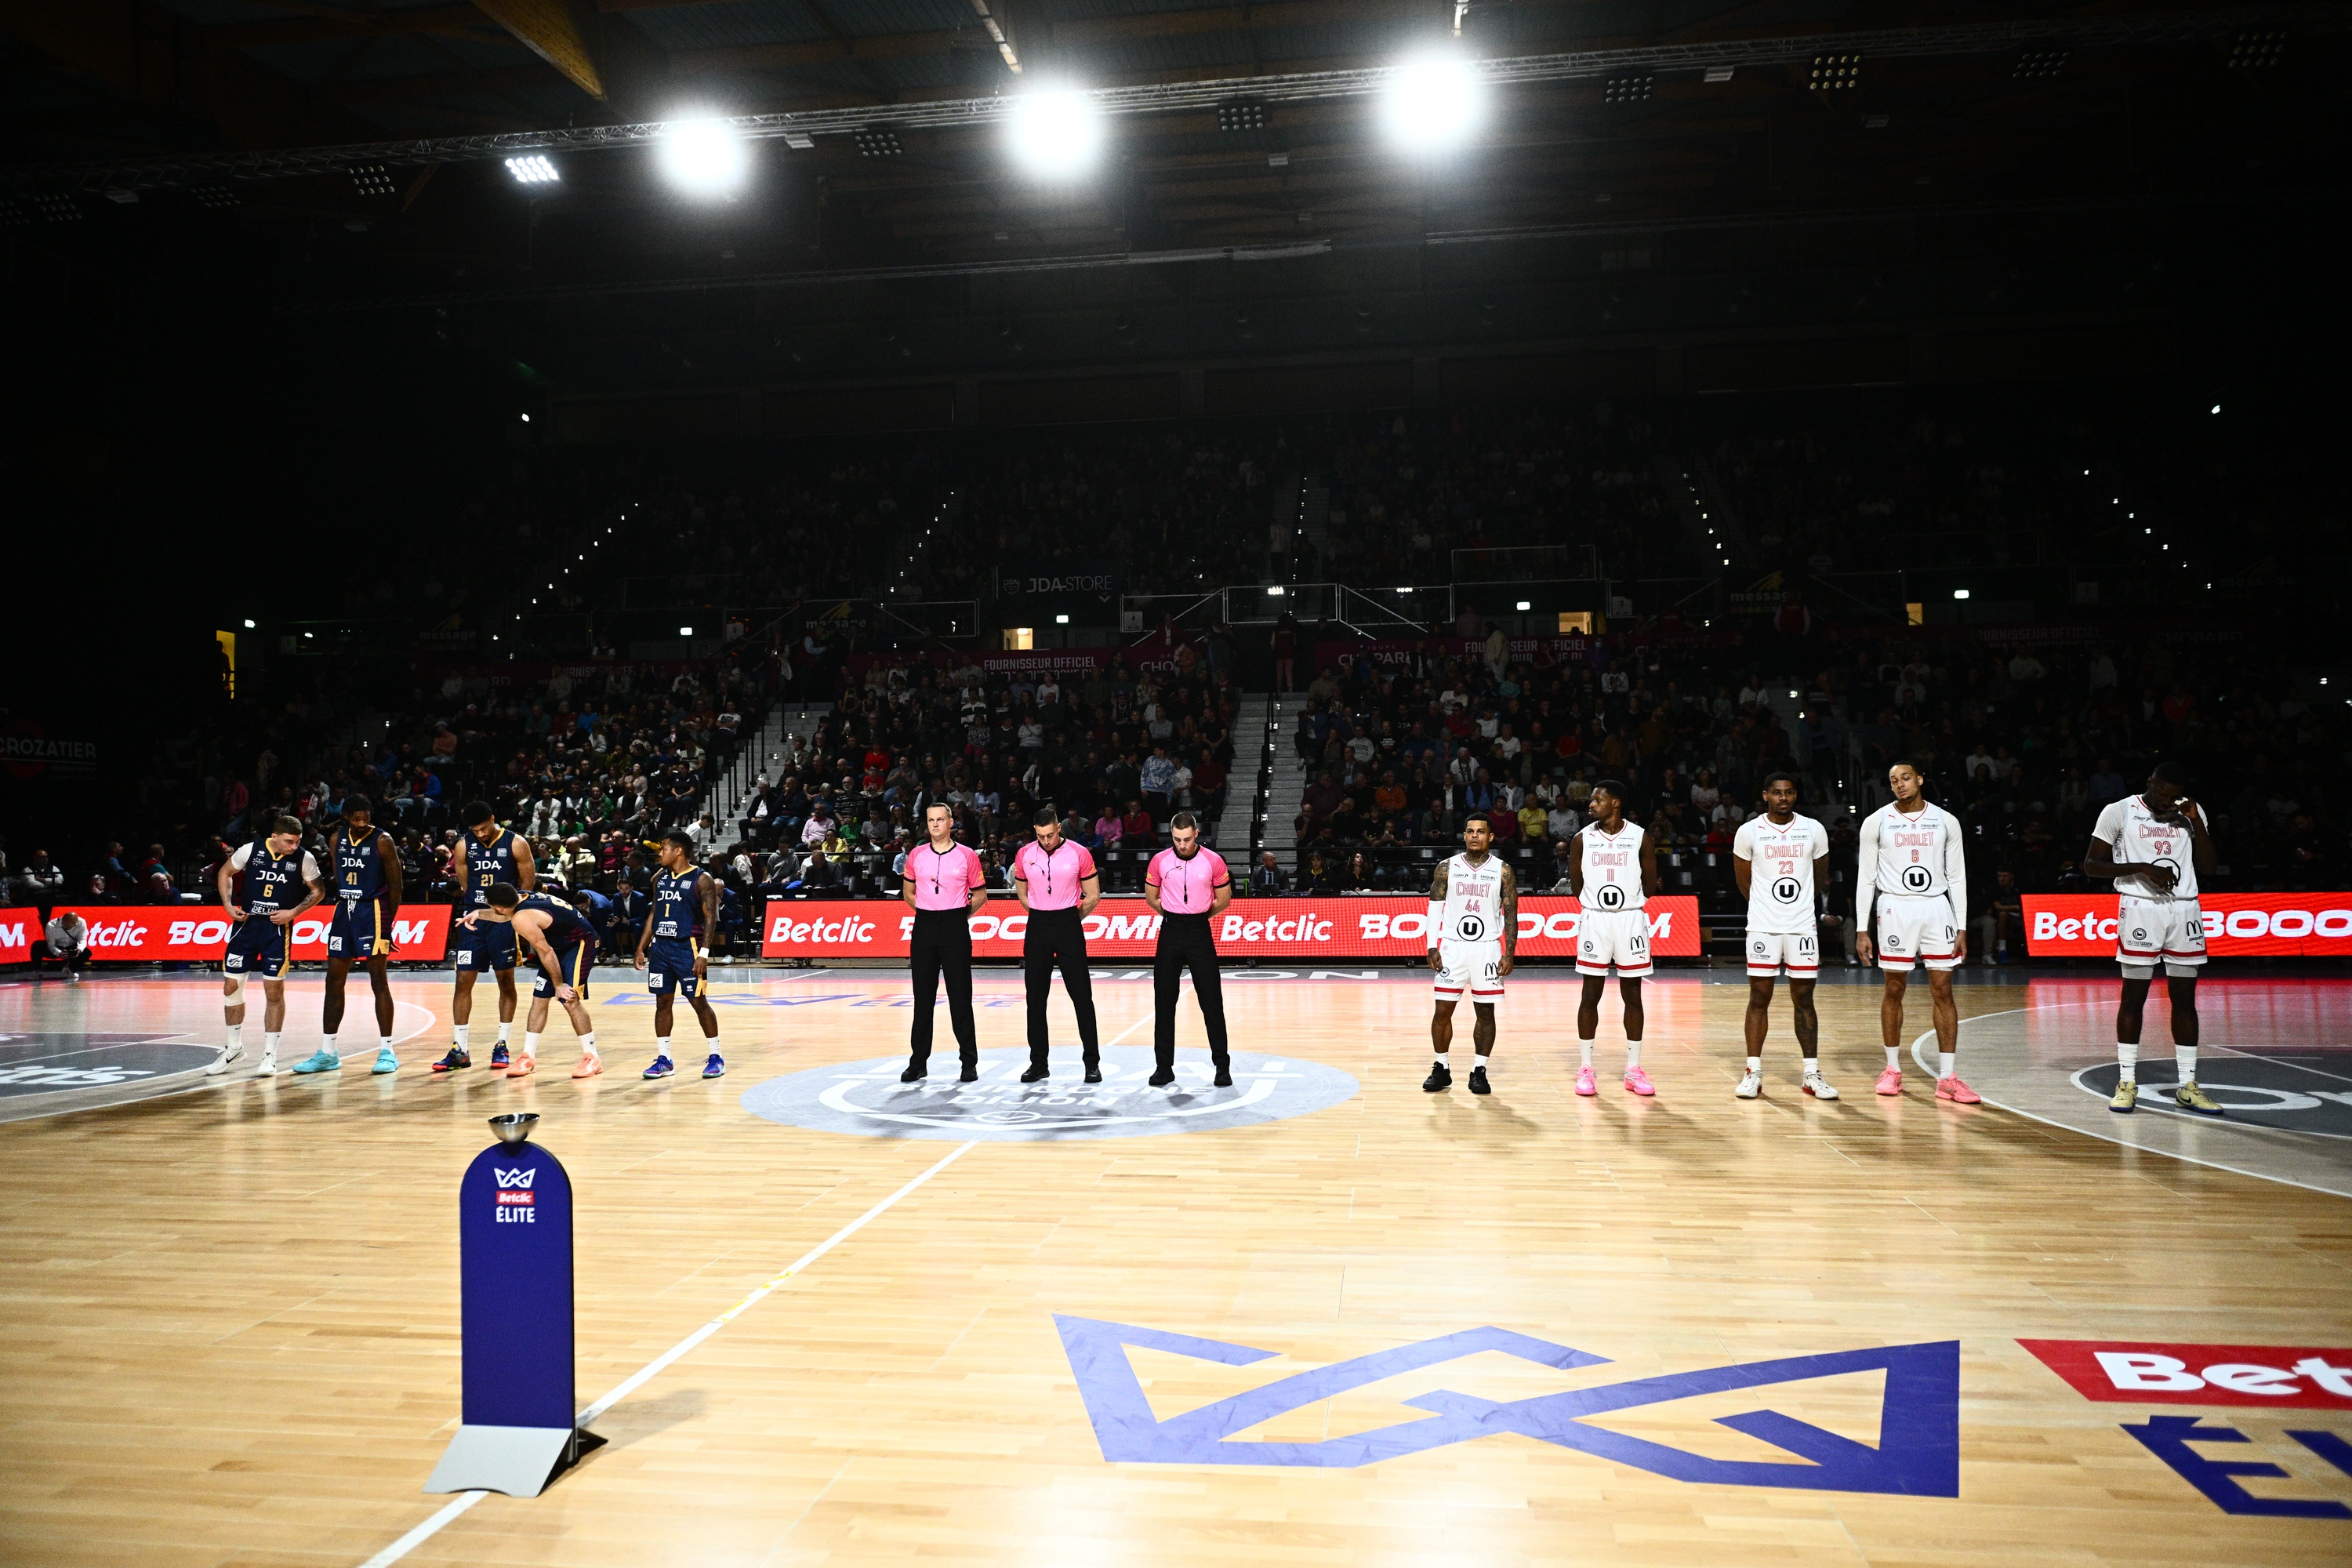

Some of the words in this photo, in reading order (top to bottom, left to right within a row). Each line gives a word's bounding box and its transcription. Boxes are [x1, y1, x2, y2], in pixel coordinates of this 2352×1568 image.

[983, 658, 1052, 671] FOURNISSEUR
[1053, 656, 1098, 669] OFFICIEL
[1894, 831, 1934, 848] CHOLET
[1764, 843, 1805, 860] CHOLET
[2154, 840, 2172, 855] 93
[1592, 851, 1629, 866] CHOLET
[1911, 849, 1919, 863] 8
[341, 858, 365, 869] JDA
[474, 860, 503, 871] JDA
[1778, 860, 1794, 875] 23
[256, 870, 288, 884] JDA
[346, 872, 358, 886] 41
[481, 873, 494, 887] 21
[1606, 868, 1615, 882] 11
[1909, 873, 1925, 887] U
[263, 884, 274, 898] 6
[658, 890, 682, 902] JDA
[1456, 881, 1491, 898] CHOLET
[1779, 884, 1795, 898] U
[1465, 899, 1480, 913] 44
[1603, 892, 1617, 906] U
[664, 903, 670, 917] 1
[769, 915, 876, 943] Betclic
[1220, 913, 1334, 942] Betclic
[1463, 922, 1478, 936] U
[880, 1083, 1215, 1095] BOURGOGNE
[946, 1095, 1121, 1106] DIJON
[499, 1192, 532, 1203] Betclic
[495, 1205, 535, 1223] ÉLITE
